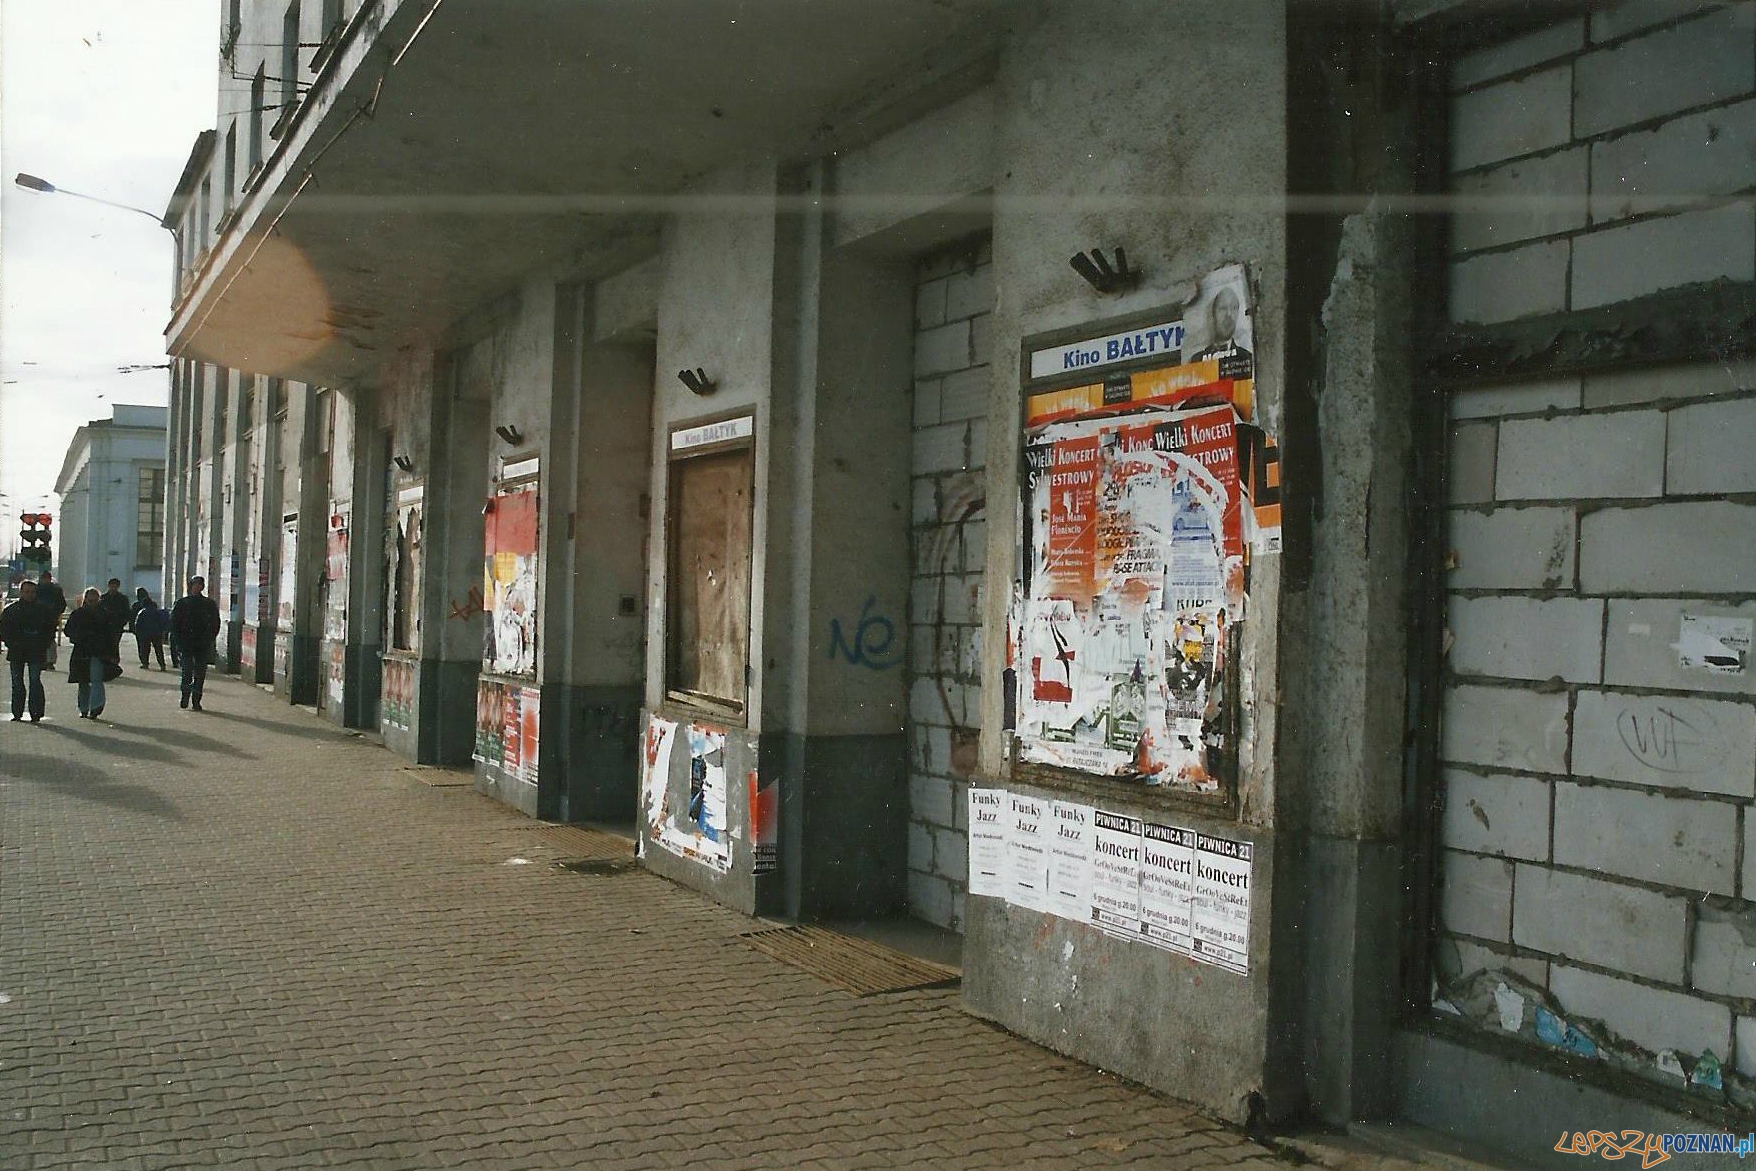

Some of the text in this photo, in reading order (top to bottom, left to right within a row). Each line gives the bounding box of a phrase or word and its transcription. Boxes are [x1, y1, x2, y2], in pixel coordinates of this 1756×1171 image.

[1063, 349, 1100, 369] Kino
[972, 792, 1001, 808] Funky
[1012, 799, 1042, 819] Funky
[976, 810, 997, 822] Jazz
[1053, 805, 1086, 825] Funky
[1096, 813, 1141, 834] PIWNICA 21
[1016, 819, 1038, 833] Jazz
[1057, 824, 1081, 839] Jazz
[1145, 825, 1193, 847] PIWNICA 21
[1095, 835, 1139, 862] koncert
[1198, 835, 1250, 859] PIWNICA 21
[1144, 847, 1192, 875] koncert
[1197, 859, 1248, 889] koncert
